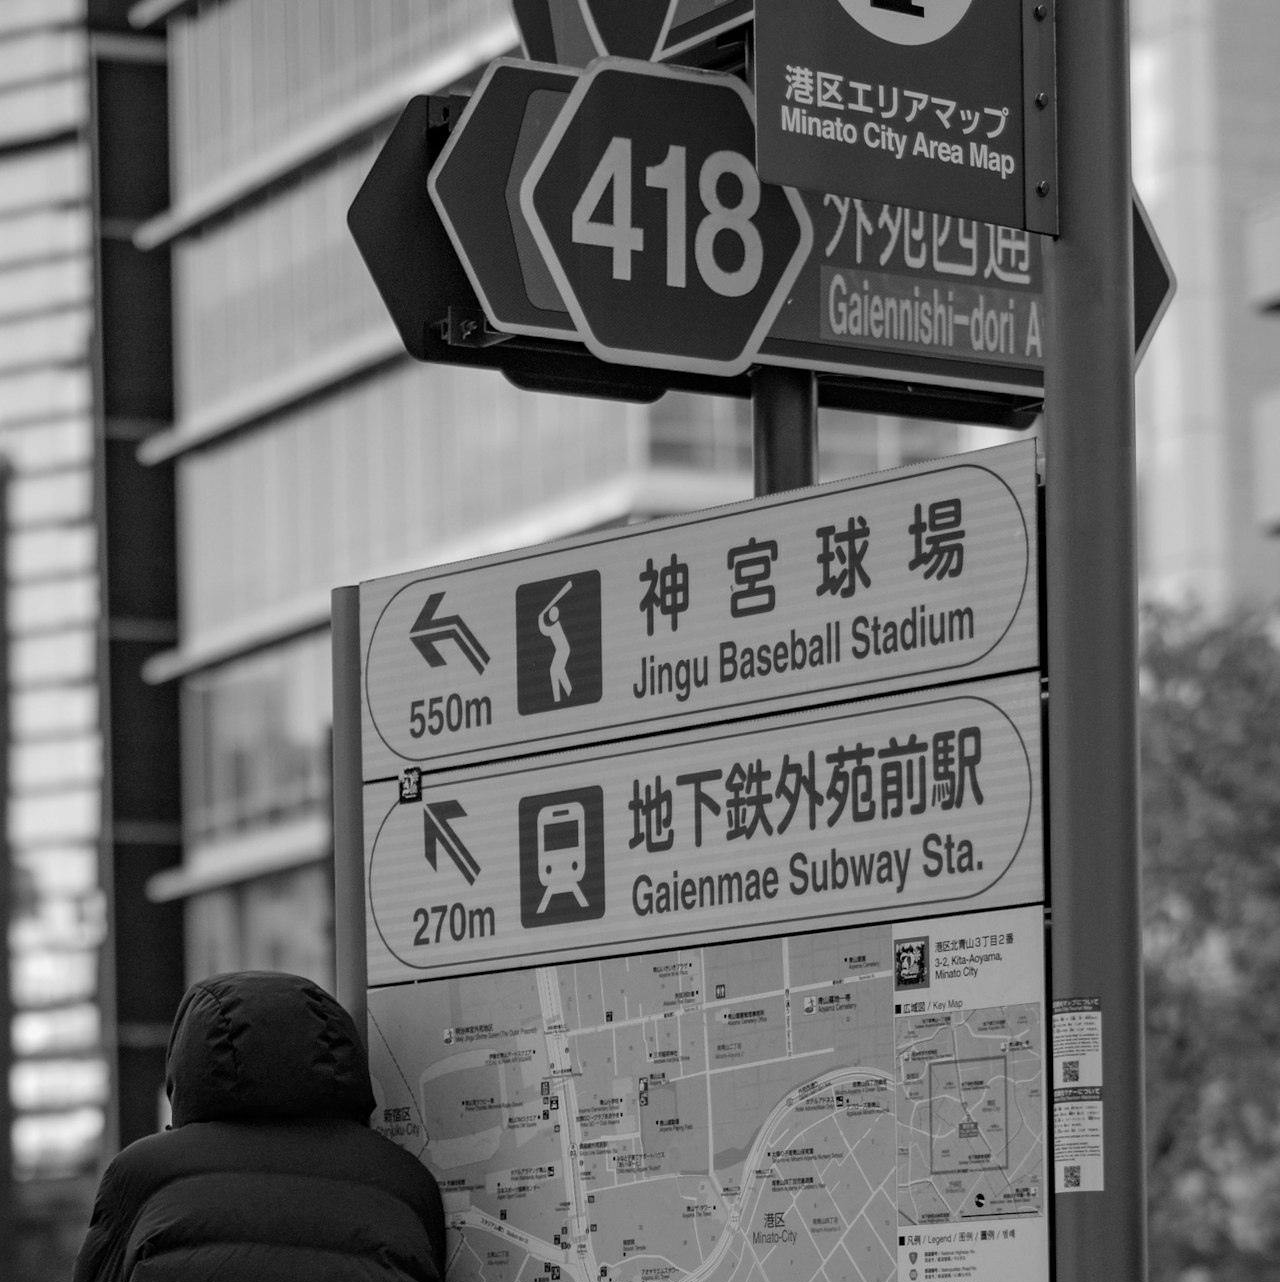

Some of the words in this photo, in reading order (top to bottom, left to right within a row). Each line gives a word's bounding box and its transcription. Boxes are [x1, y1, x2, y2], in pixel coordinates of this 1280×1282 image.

[785, 64, 1009, 139] 港区エリアマップ
[781, 105, 857, 144] Minato
[864, 122, 907, 159] City
[912, 132, 963, 165] Area
[970, 142, 1014, 179] Map
[572, 137, 764, 297] 418
[828, 273, 1014, 355] Gaiennishi-dori
[639, 498, 965, 636] 神宮球場
[632, 651, 709, 702] Jingu
[720, 620, 840, 682] Baseball
[851, 606, 974, 662] Stadium
[409, 695, 492, 739] 550m
[629, 725, 984, 853] 地下鉄外苑前駅
[631, 861, 779, 917] Gaienmae
[789, 846, 911, 898] Subway
[921, 832, 984, 878] Sta.
[412, 900, 495, 947] 270m
[935, 933, 1014, 953] 港区北青山3丁目2番
[935, 957, 949, 968] 3-2,
[951, 952, 1002, 965] Kita-Aoyama,
[935, 970, 961, 980] Minato
[963, 967, 978, 978] City
[837, 1003, 856, 1012] Cemetery
[933, 1001, 946, 1010] Key
[948, 1000, 963, 1009] Map
[753, 1230, 797, 1244] Minato-City
[764, 1212, 785, 1228] 港区
[928, 1234, 952, 1246] Legend
